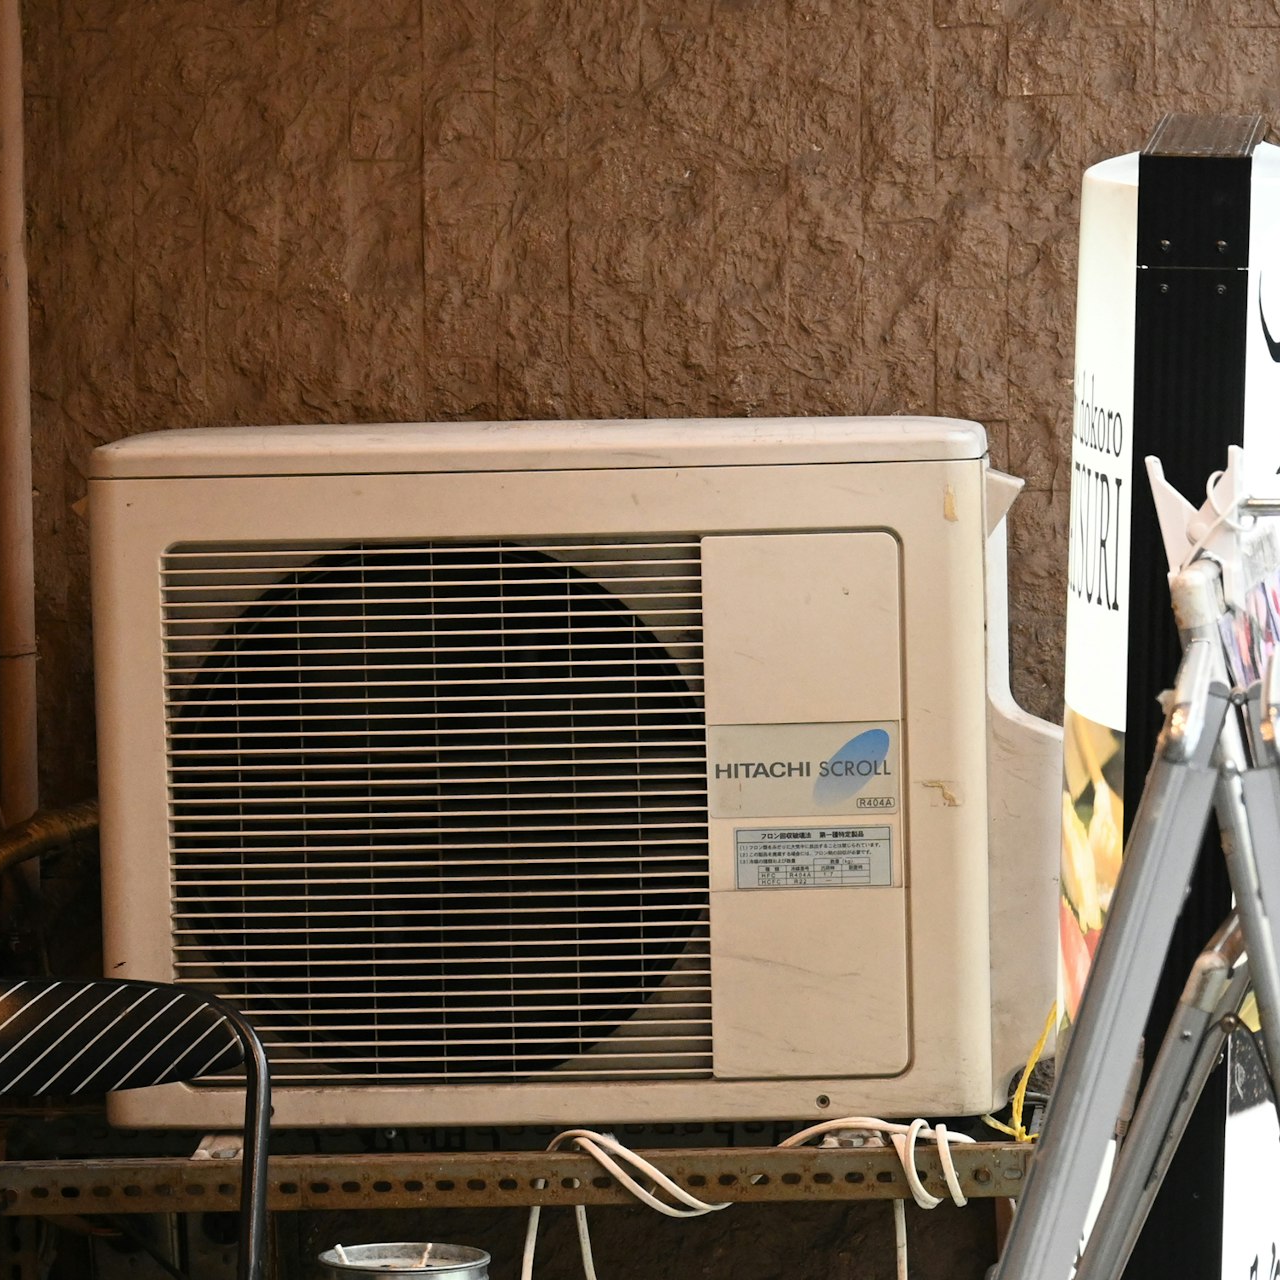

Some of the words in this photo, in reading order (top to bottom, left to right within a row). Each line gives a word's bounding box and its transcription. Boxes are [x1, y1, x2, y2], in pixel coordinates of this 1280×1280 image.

[715, 761, 811, 779] HITACHI
[819, 759, 892, 778] SCROLL
[859, 797, 892, 807] R404A
